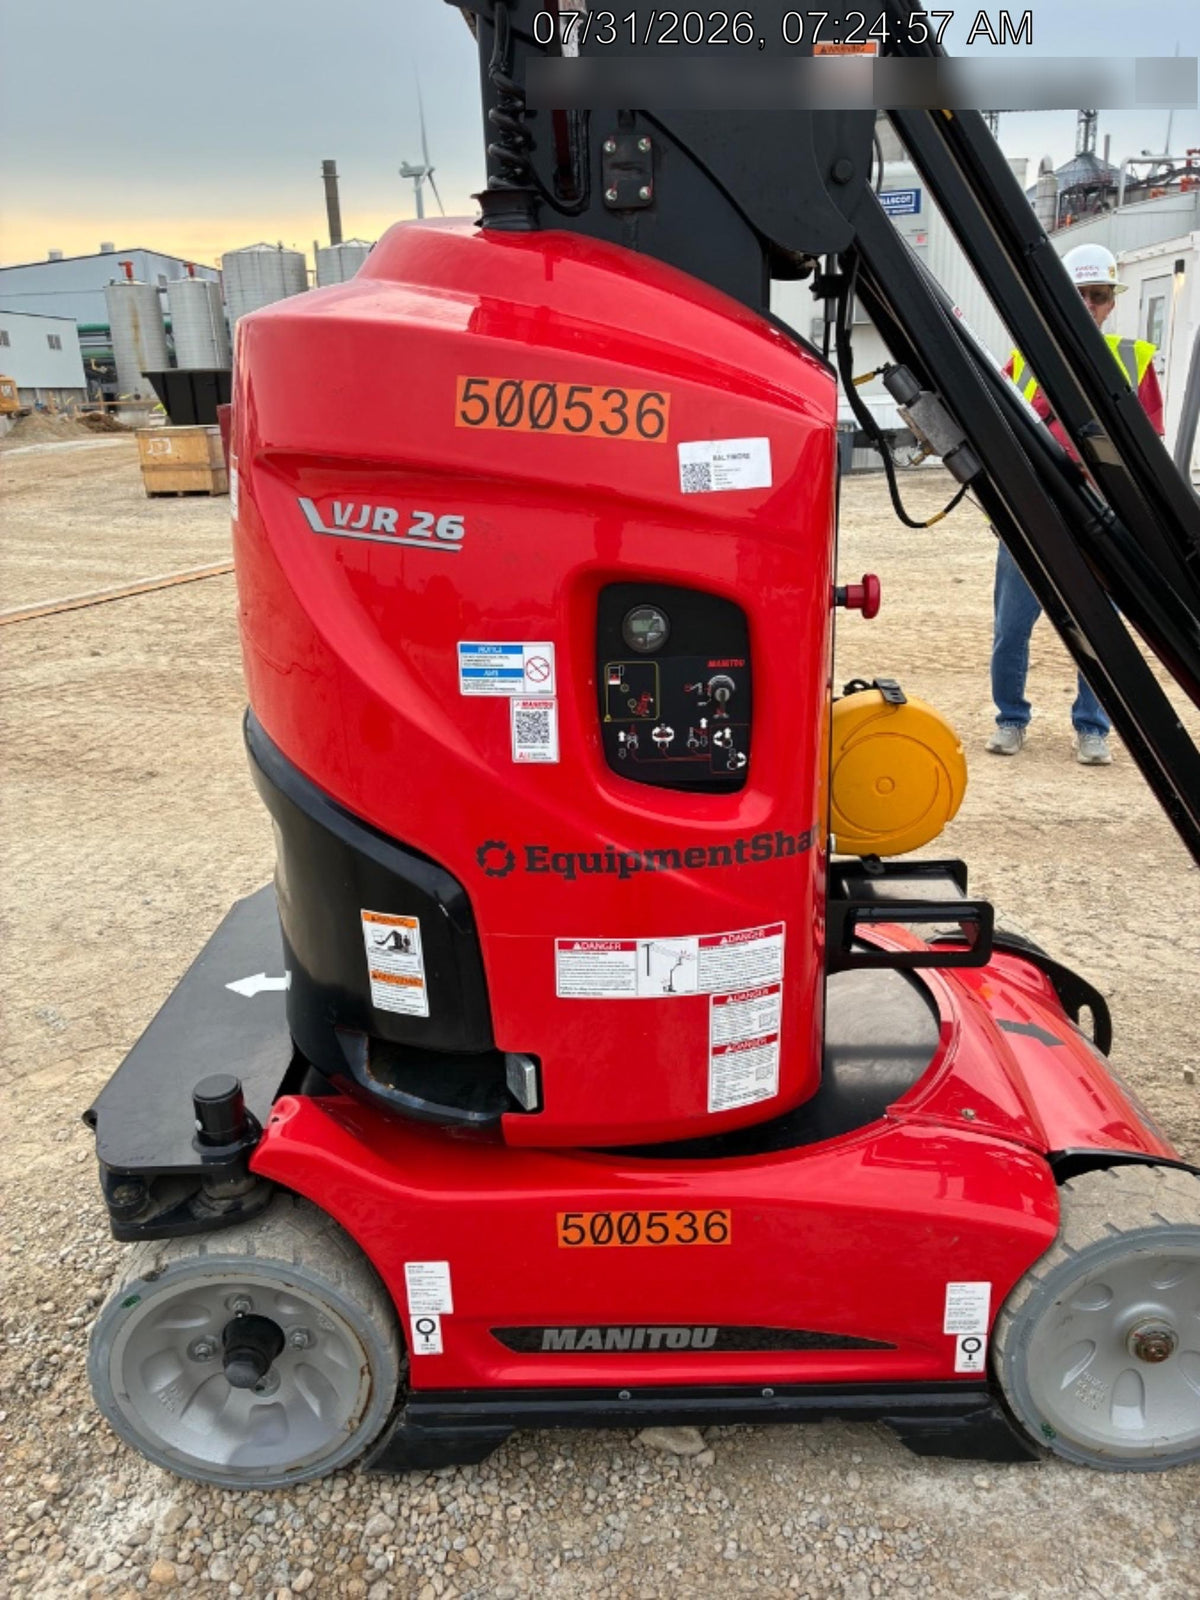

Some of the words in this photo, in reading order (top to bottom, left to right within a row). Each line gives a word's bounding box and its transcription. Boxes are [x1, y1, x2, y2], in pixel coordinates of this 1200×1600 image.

[460, 378, 666, 439] 500536
[332, 501, 399, 533] VJR
[407, 510, 465, 541] 26
[707, 658, 745, 667] MANITOU
[581, 942, 621, 950] DANGER
[728, 929, 765, 943] DANGER
[562, 1210, 728, 1245] 500536
[541, 1327, 719, 1350] MANITOU
